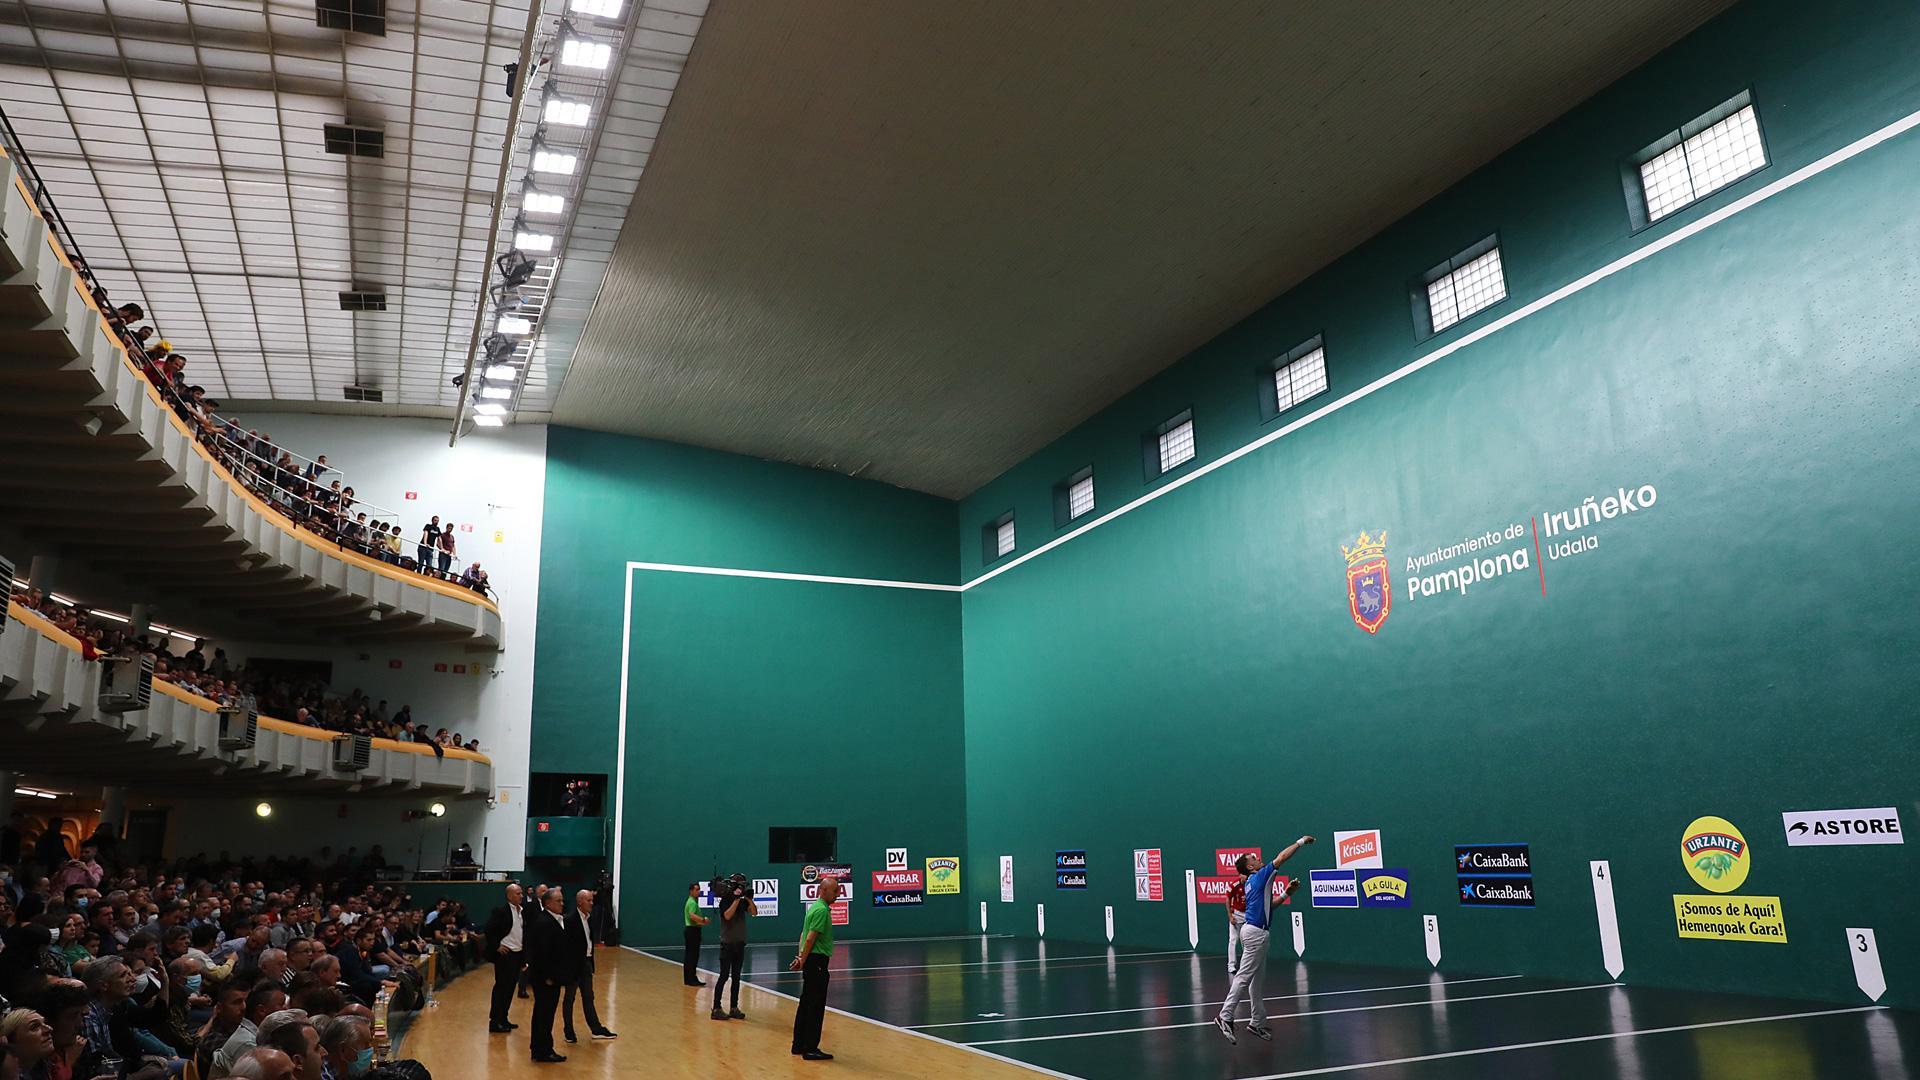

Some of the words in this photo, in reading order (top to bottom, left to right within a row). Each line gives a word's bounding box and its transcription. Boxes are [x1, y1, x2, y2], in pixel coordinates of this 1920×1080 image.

[1543, 484, 1657, 537] Iruñeko
[1406, 530, 1502, 573] Ayuntamiento
[1505, 523, 1524, 540] de
[1548, 534, 1599, 560] Udala
[1407, 547, 1530, 601] Pamplona
[1813, 818, 1899, 836] ASTORE
[1343, 838, 1374, 858] Krissia
[1687, 835, 1740, 853] URZANTE
[888, 851, 905, 864] DV
[930, 859, 956, 869] URZANTE
[1063, 855, 1086, 865] CaixaBank
[1472, 852, 1529, 868] CaixaBank
[883, 873, 919, 884] AMBAR
[1063, 875, 1086, 885] CaixaBank
[1597, 865, 1604, 880] 4
[754, 880, 776, 894] DN
[1314, 884, 1355, 893] AGUINAMAR
[1367, 882, 1378, 892] LA
[1379, 880, 1400, 892] GULA
[1476, 883, 1532, 900] CaixaBank
[885, 893, 922, 904] CaixaBank
[1681, 901, 1722, 918] ¡Somos
[1726, 903, 1740, 916] de
[1744, 903, 1776, 920] Aquí!
[1294, 915, 1300, 927] 6
[1428, 919, 1434, 932] 5
[1678, 918, 1746, 936] Hemengoak
[1749, 921, 1784, 936] Gara!
[1856, 934, 1868, 952] 3
